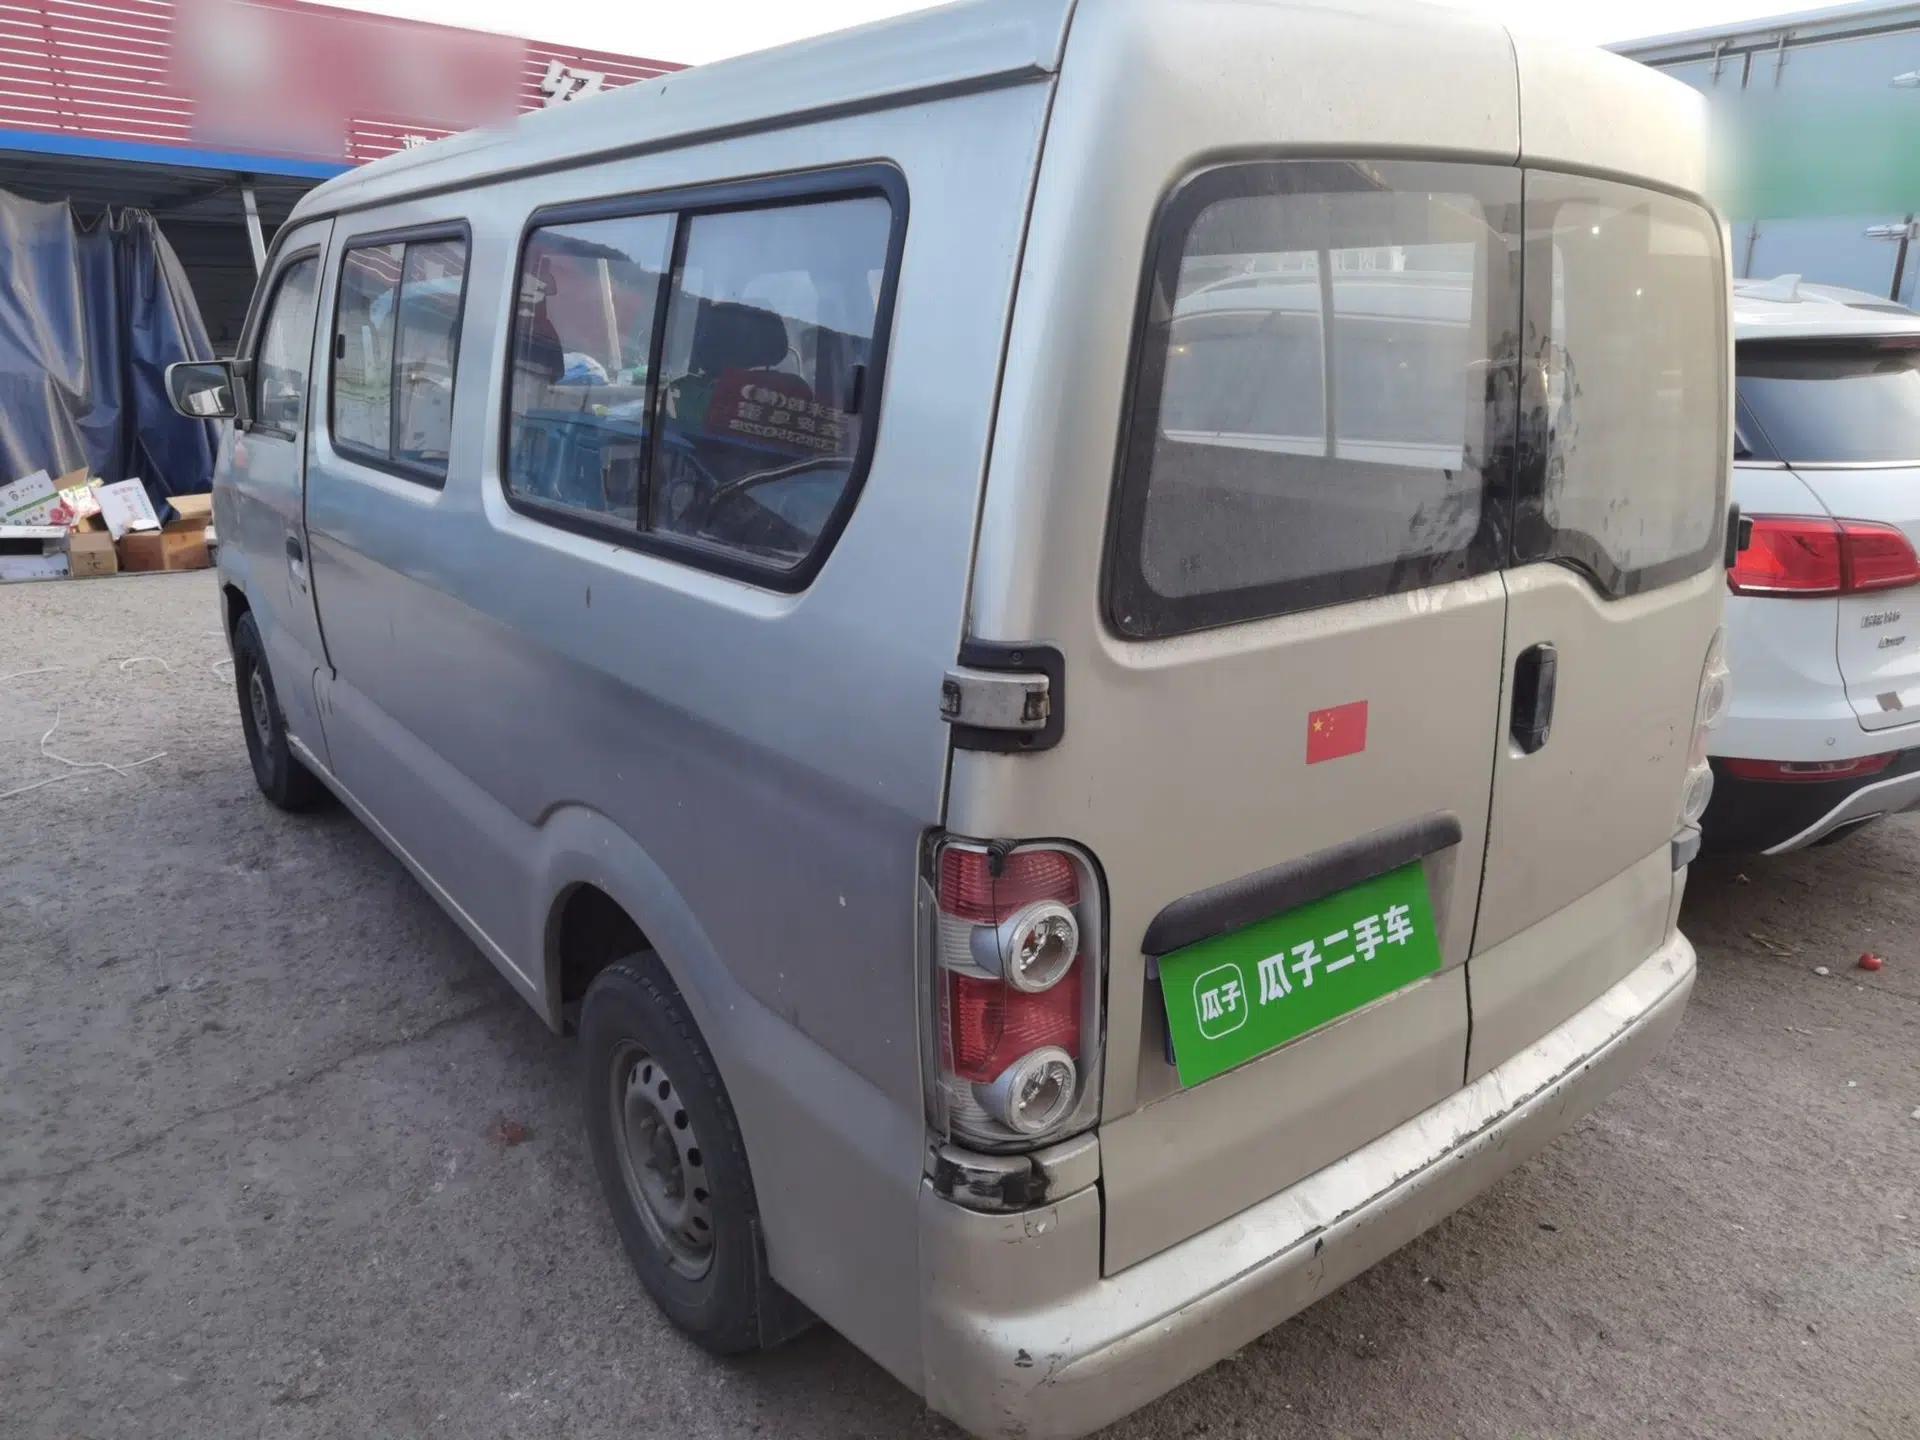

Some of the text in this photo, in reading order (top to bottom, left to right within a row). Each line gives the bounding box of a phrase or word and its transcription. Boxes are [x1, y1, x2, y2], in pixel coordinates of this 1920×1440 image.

[1257, 904, 1414, 1006] 瓜子二手车
[1201, 980, 1241, 1022] 瓜子
